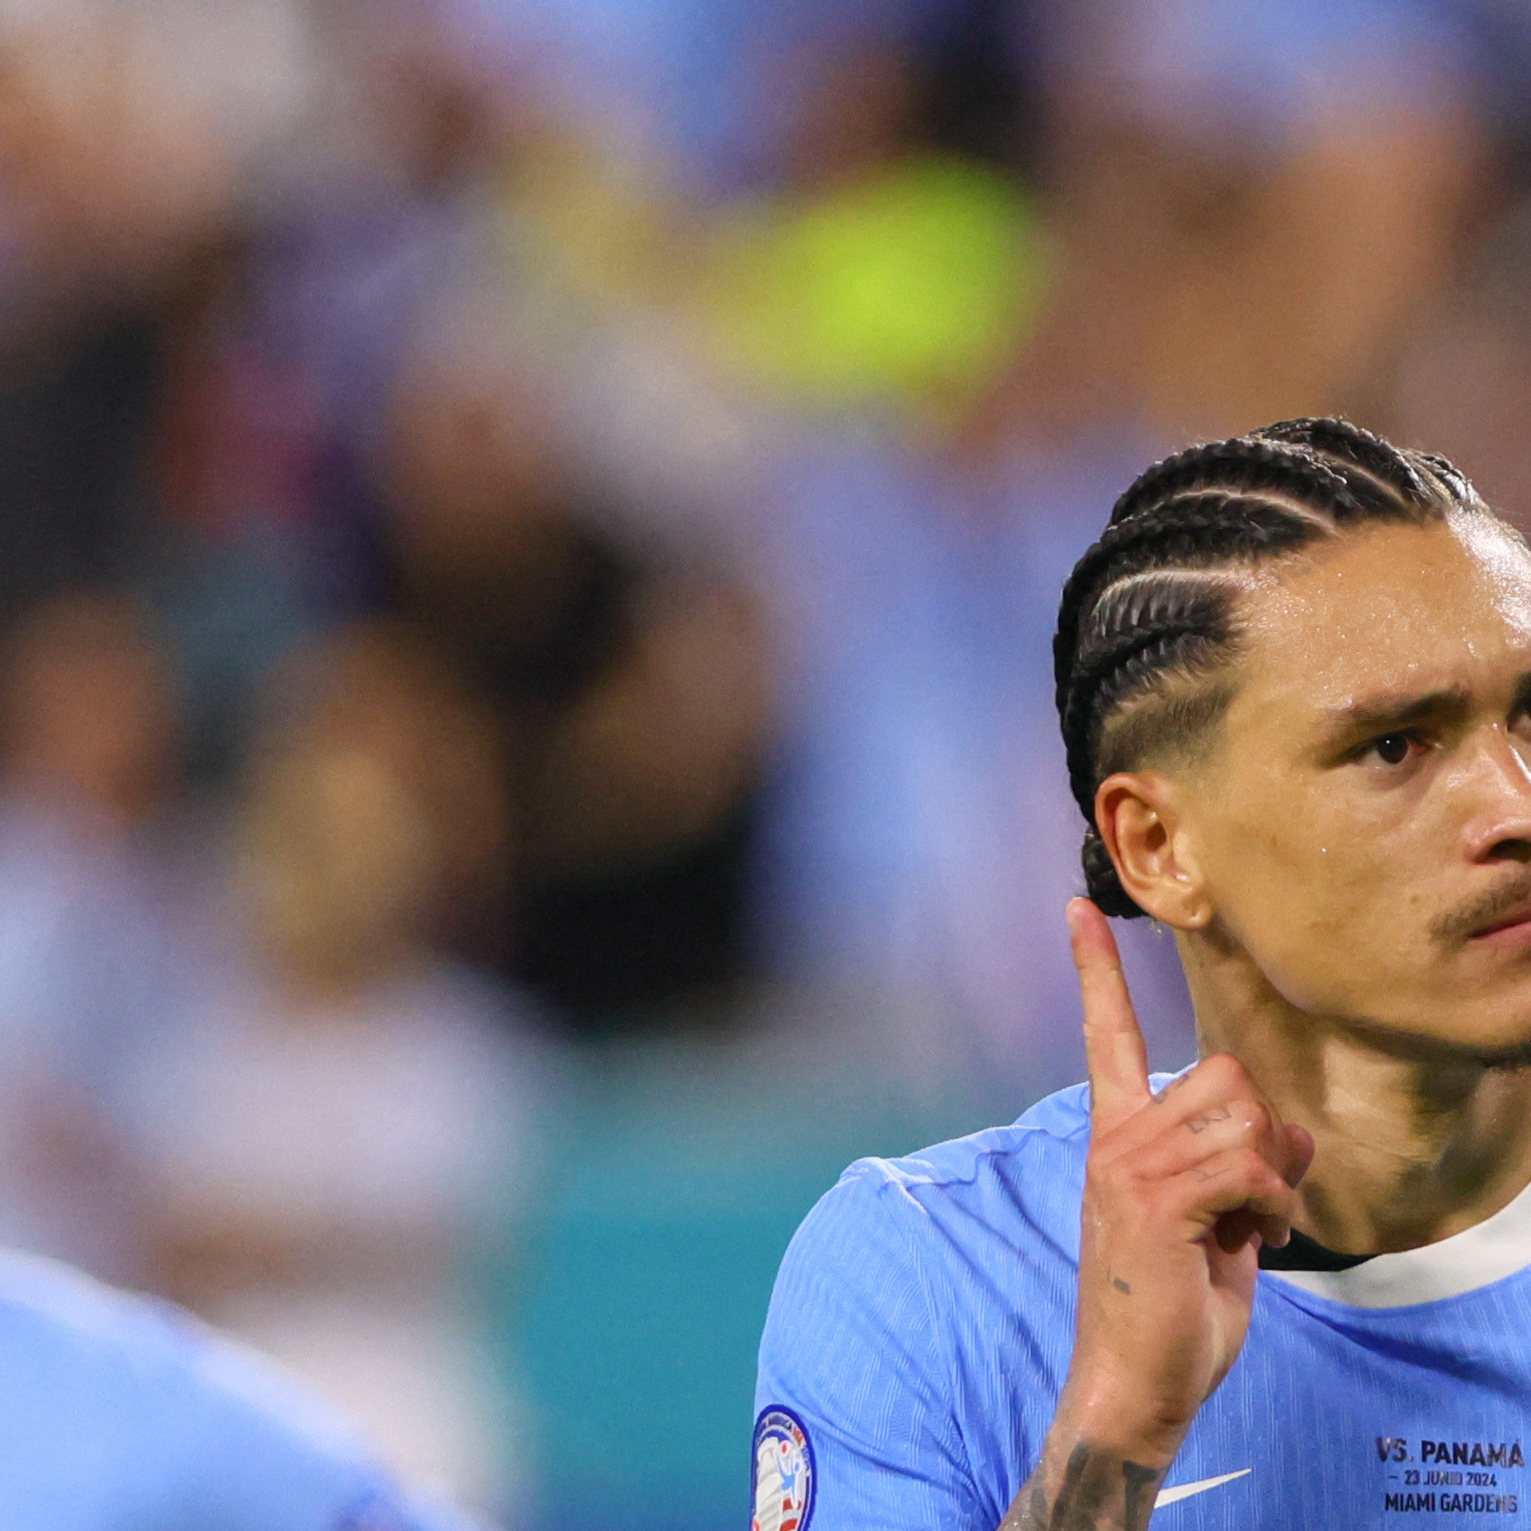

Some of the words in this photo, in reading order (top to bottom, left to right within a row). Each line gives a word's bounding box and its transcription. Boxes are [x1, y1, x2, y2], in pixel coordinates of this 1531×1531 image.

[1375, 1436, 1414, 1462] VS.
[1421, 1438, 1525, 1468] PANAMÁ
[1404, 1469, 1419, 1485] 23
[1466, 1472, 1497, 1487] 2024
[1384, 1492, 1436, 1512] MIAMI
[1440, 1493, 1518, 1513] GARDENS
